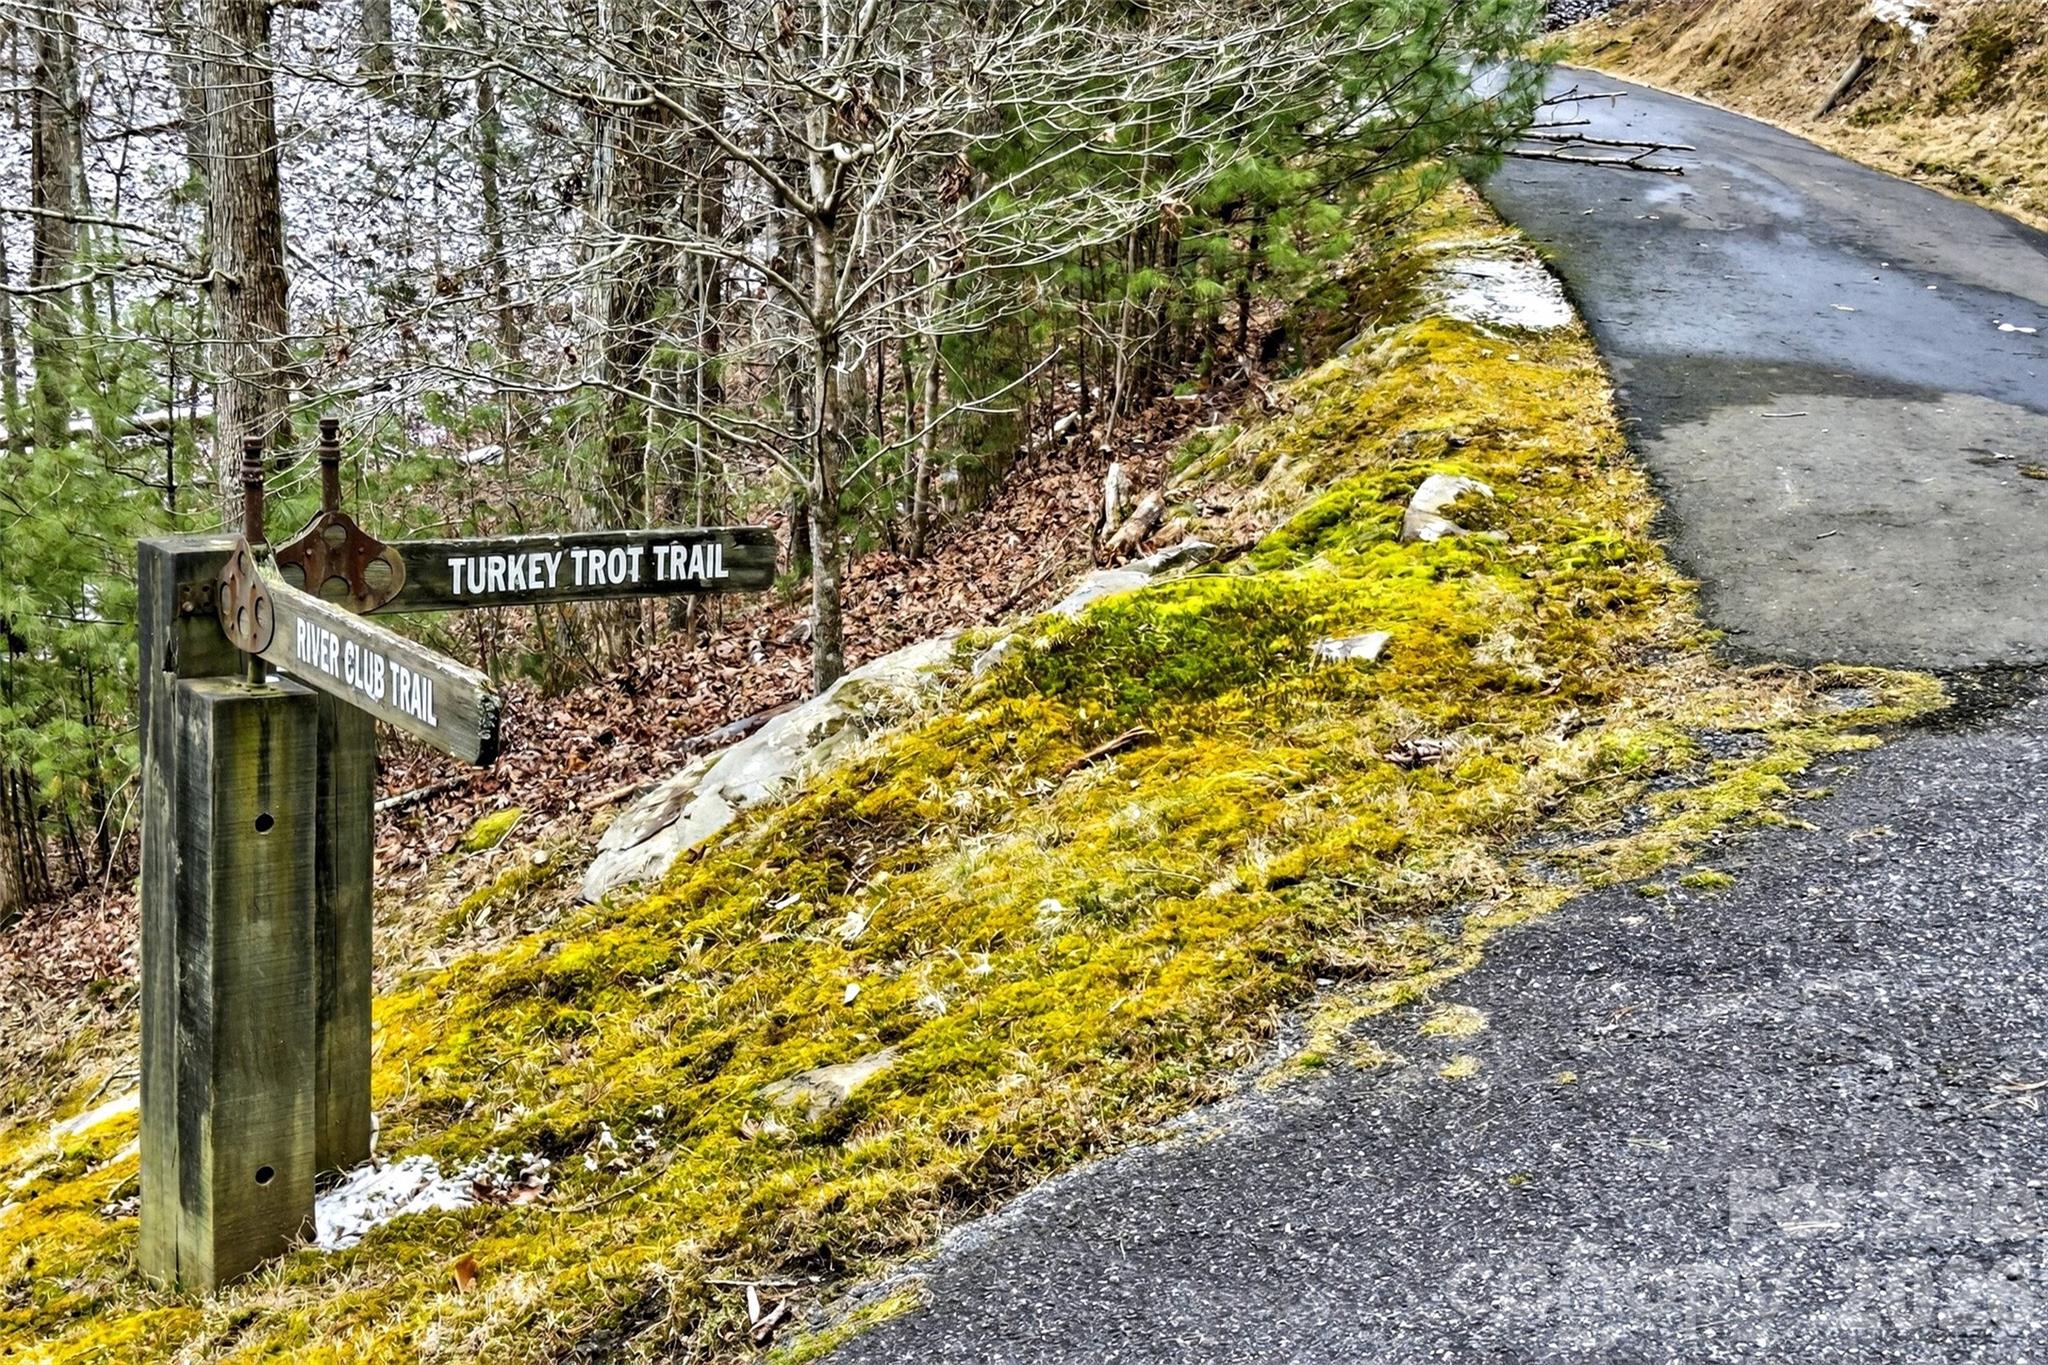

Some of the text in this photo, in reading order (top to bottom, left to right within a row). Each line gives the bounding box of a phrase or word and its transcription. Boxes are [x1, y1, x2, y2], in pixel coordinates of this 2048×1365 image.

[448, 543, 729, 595] TURKEY TROT TRAIL
[296, 616, 438, 728] RIVER CLUB TRAIL
